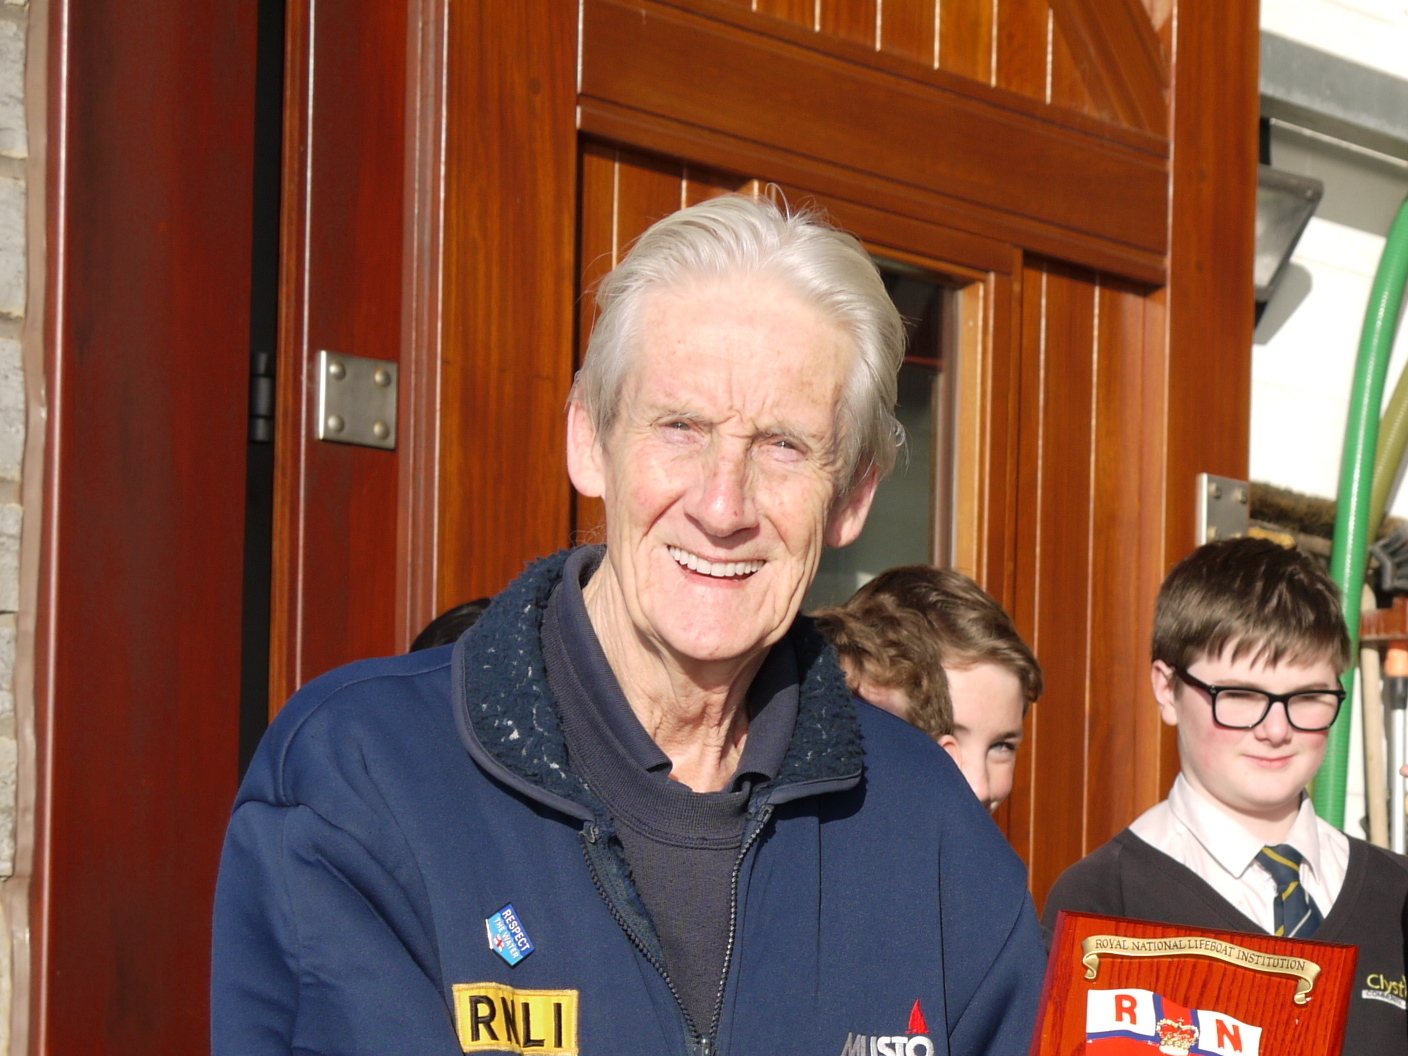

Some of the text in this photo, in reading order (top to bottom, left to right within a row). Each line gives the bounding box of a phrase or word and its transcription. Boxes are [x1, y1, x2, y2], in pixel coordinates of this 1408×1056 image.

[493, 916, 520, 959] THE WATER
[501, 908, 531, 951] RESPECT
[1095, 938, 1306, 972] ROYAL NATIONAL LIFEBOAT INSTITUTION
[468, 994, 563, 1049] RNLI
[1114, 994, 1243, 1053] R N
